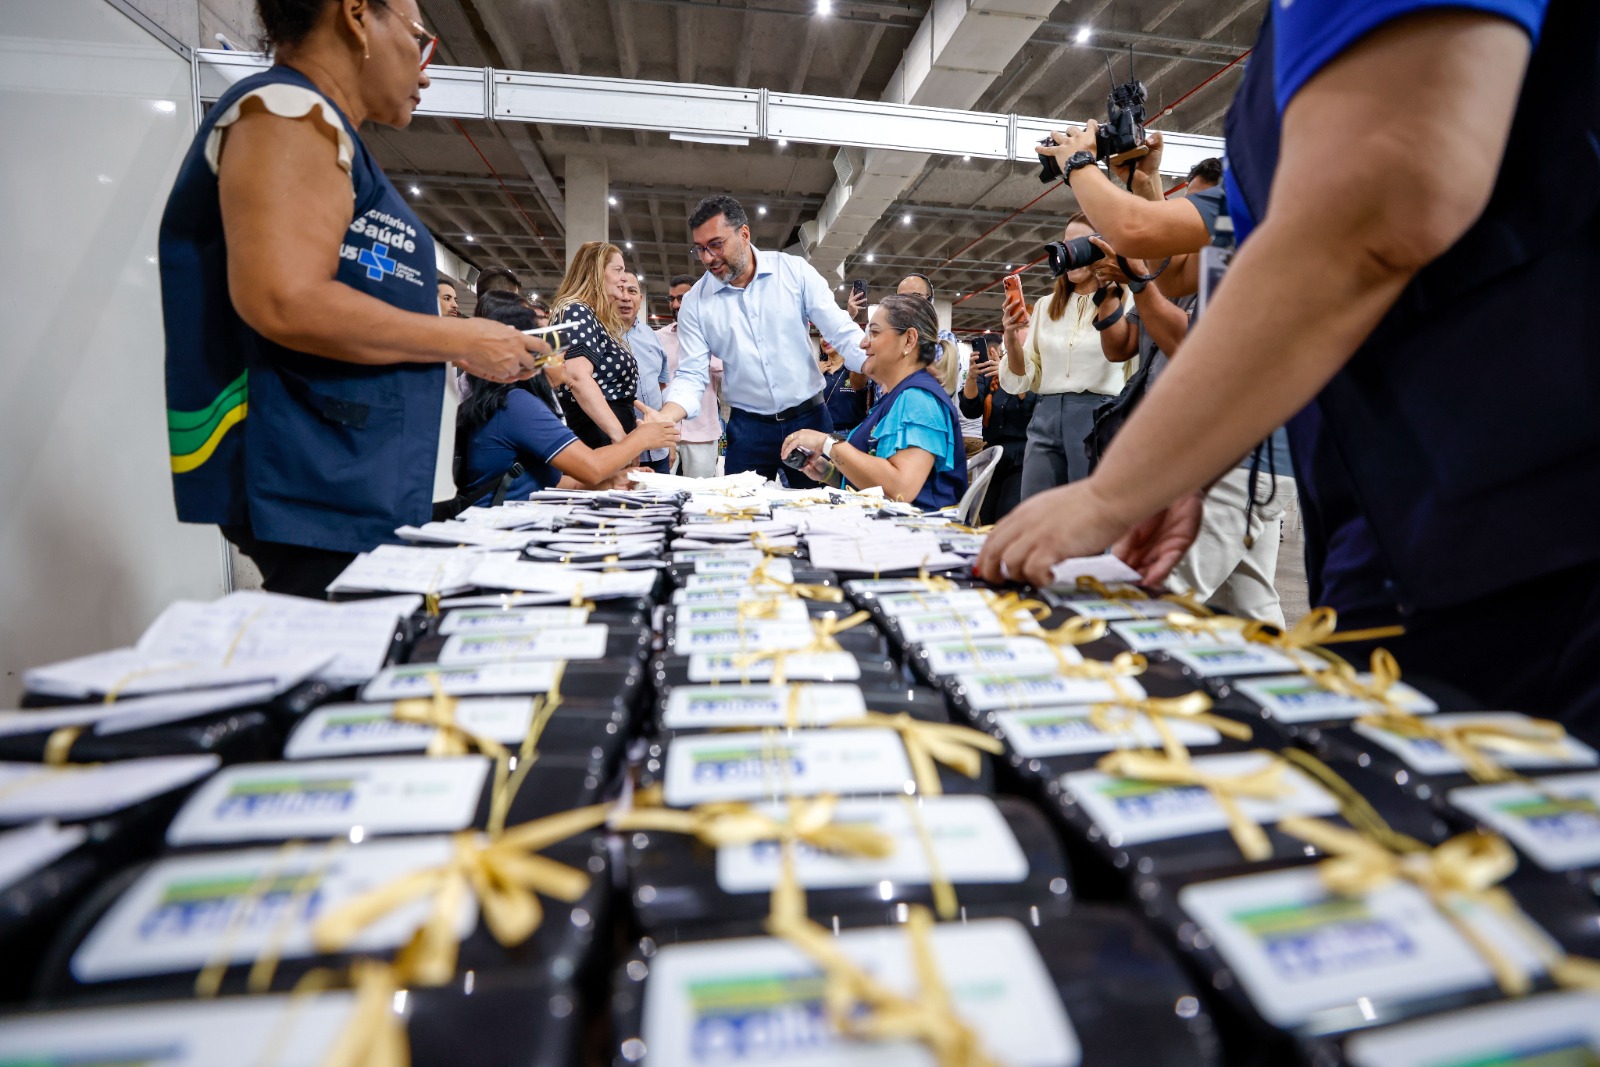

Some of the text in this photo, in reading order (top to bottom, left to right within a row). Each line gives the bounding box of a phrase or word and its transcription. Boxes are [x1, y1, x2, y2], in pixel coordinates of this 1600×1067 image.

[365, 209, 406, 232] cretaria
[349, 216, 416, 254] Saúde
[339, 243, 359, 261] US
